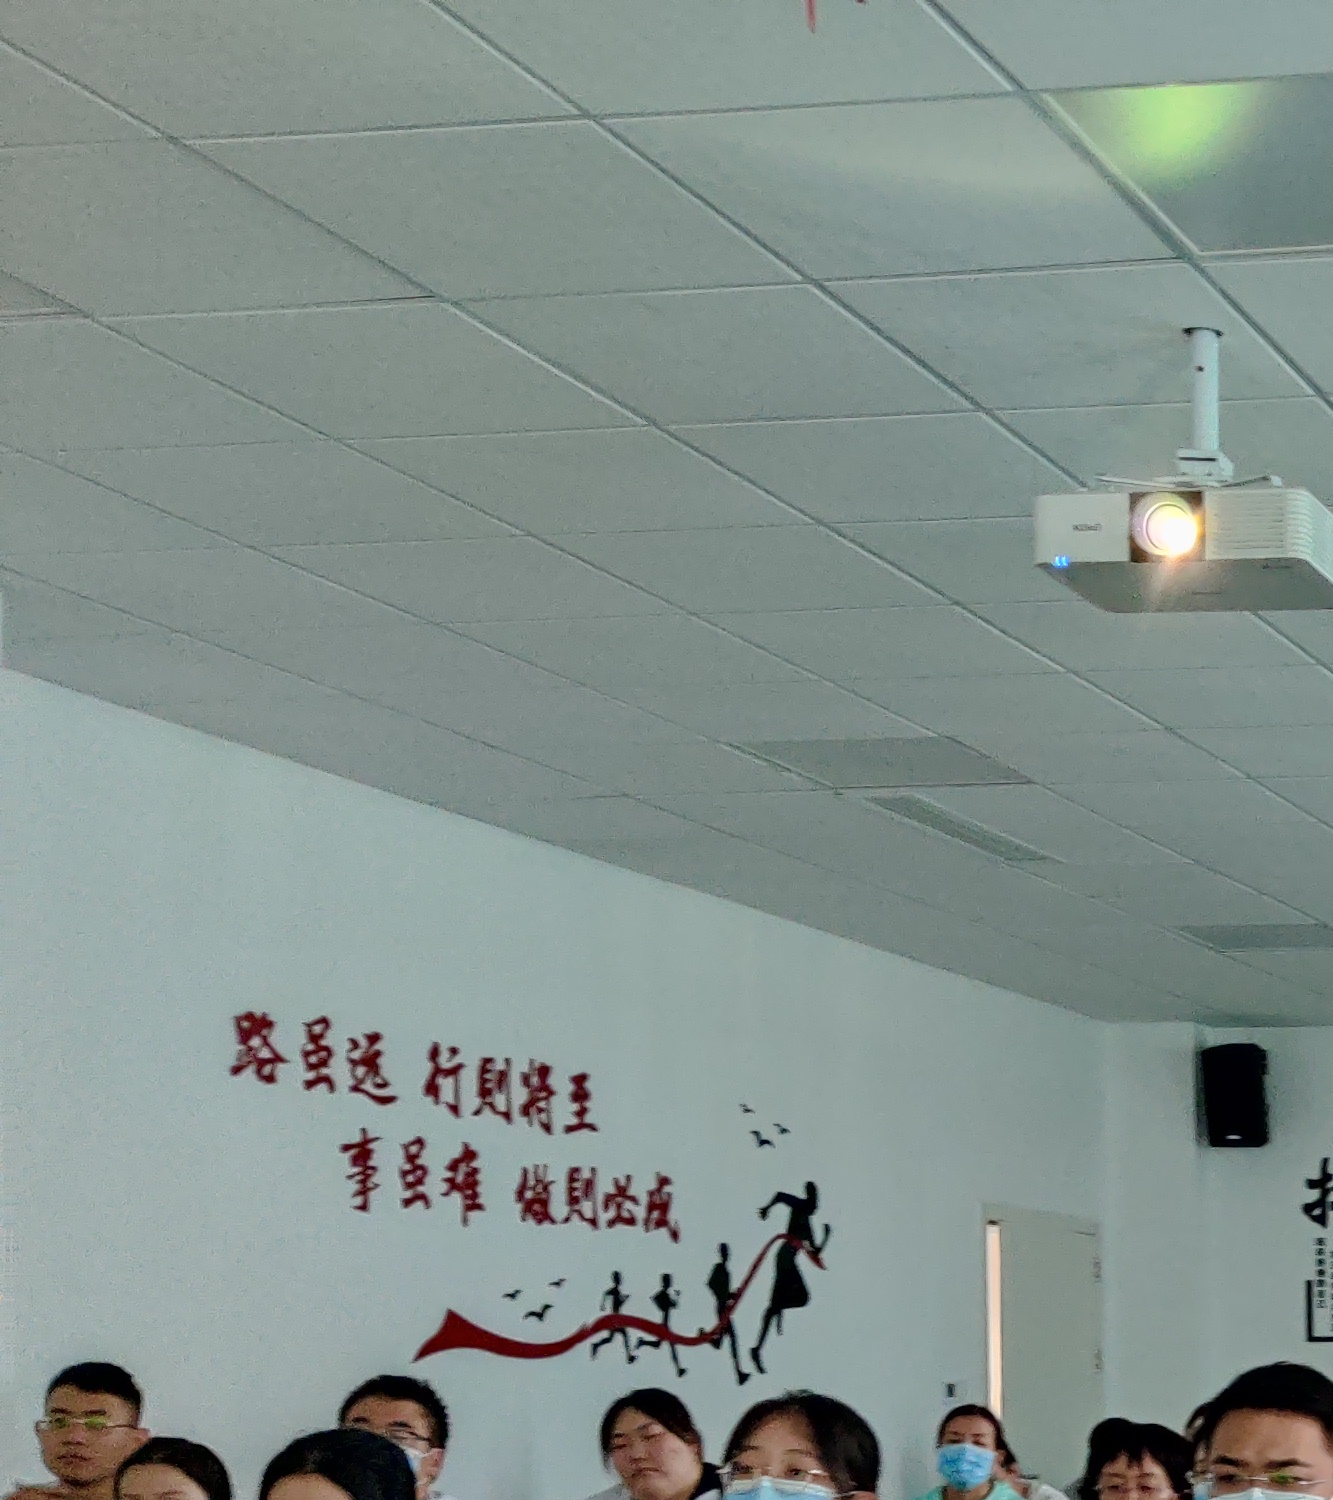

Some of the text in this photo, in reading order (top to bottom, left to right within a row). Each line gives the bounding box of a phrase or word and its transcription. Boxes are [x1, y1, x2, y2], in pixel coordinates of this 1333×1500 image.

[230, 1012, 398, 1106] 路虽远
[340, 1128, 485, 1226] 事虽难
